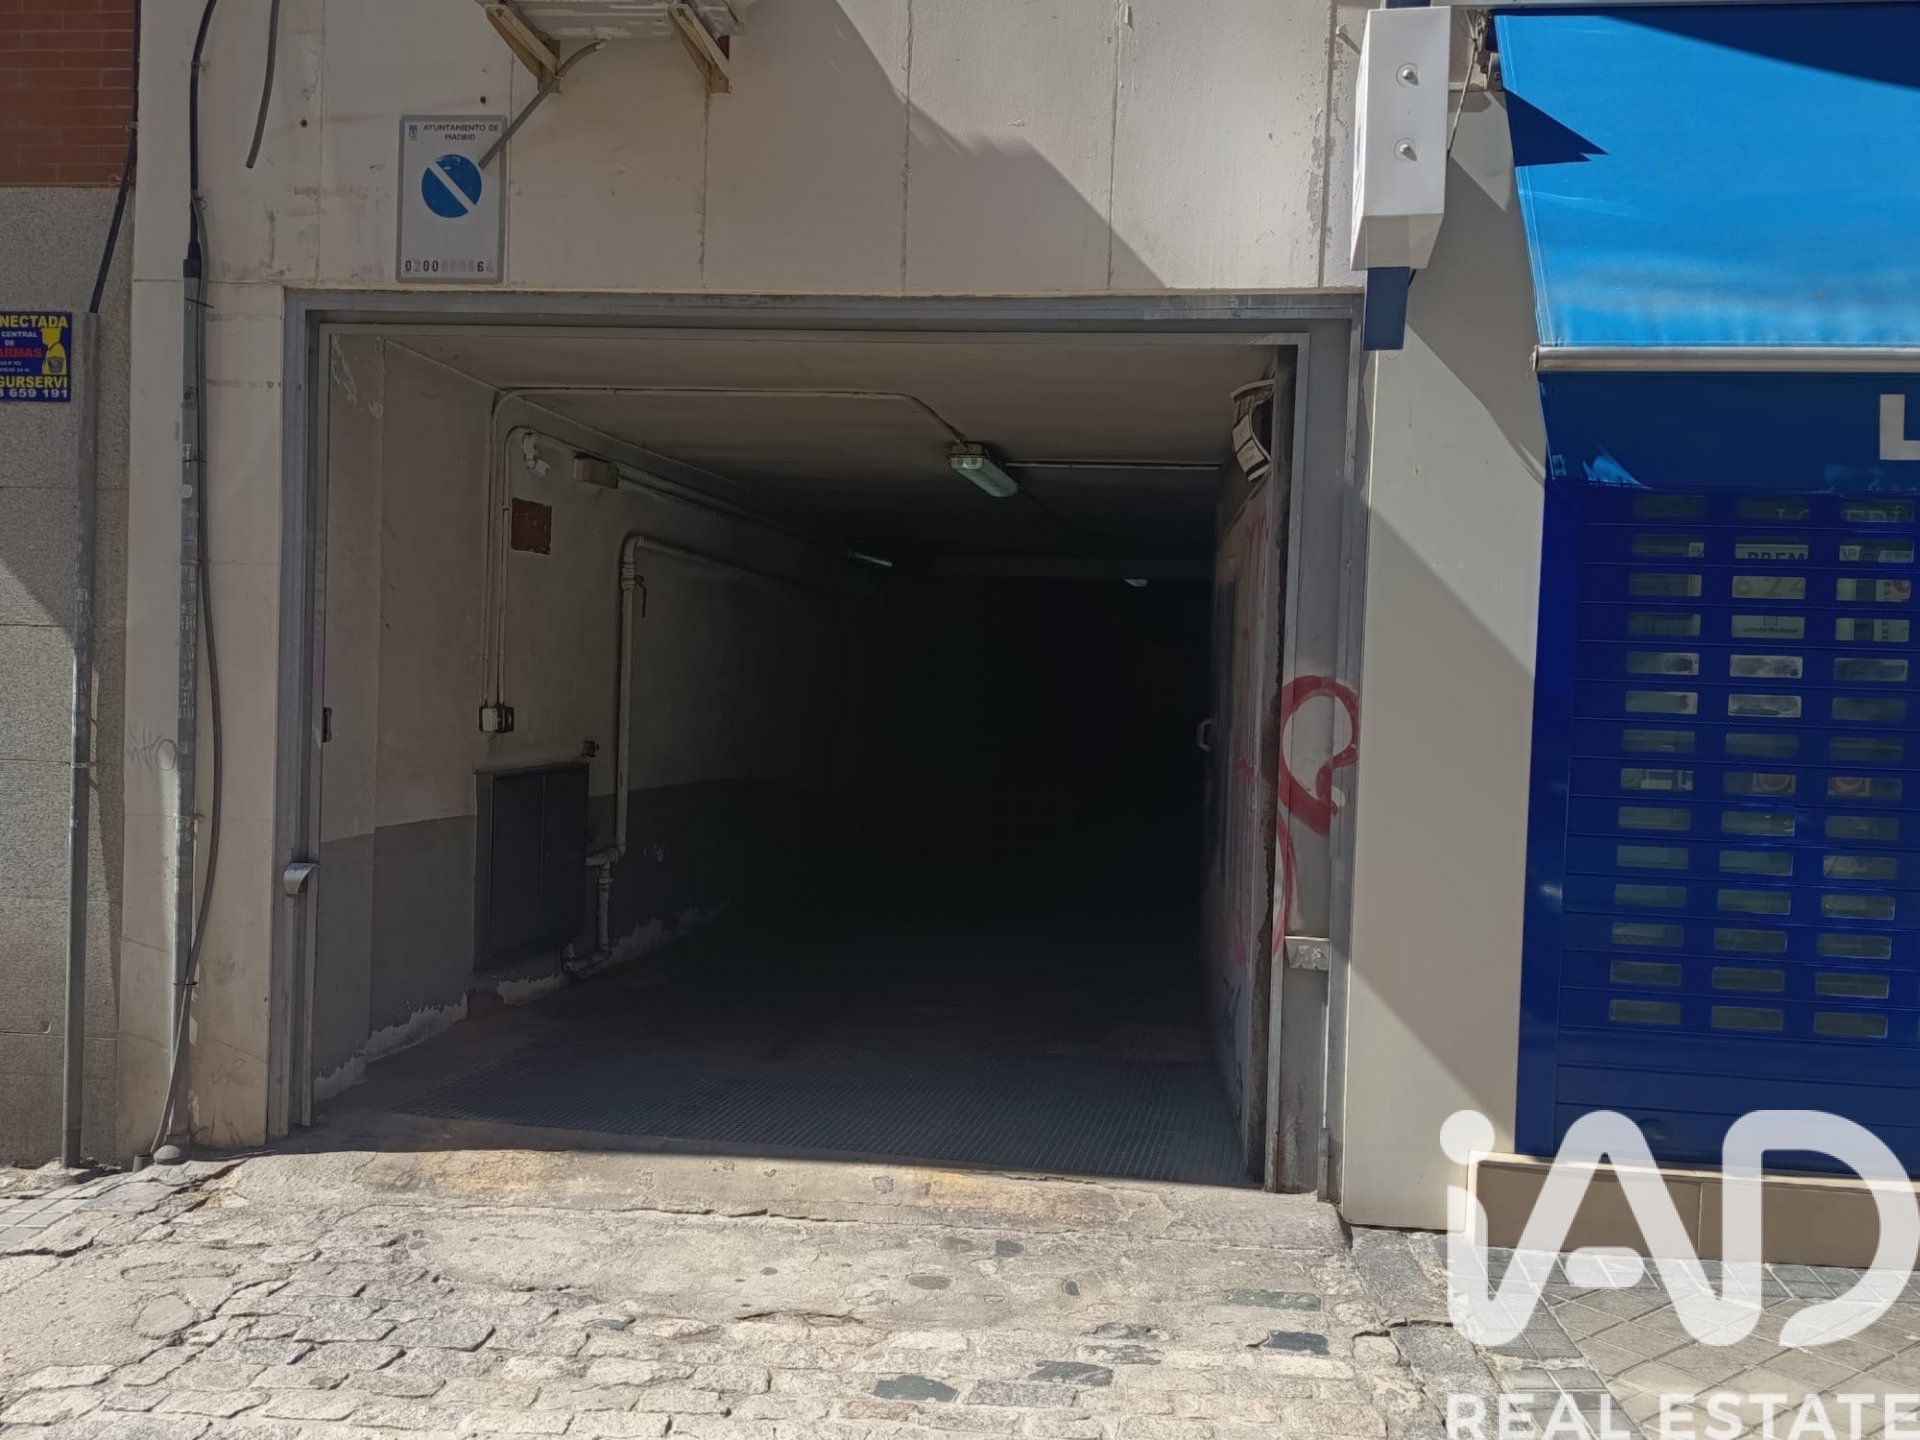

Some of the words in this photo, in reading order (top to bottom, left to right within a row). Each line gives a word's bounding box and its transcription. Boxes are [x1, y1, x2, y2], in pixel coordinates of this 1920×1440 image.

[445, 133, 477, 141] MADRID
[9, 388, 37, 398] 659
[42, 389, 68, 398] 191
[1880, 393, 1920, 460] L
